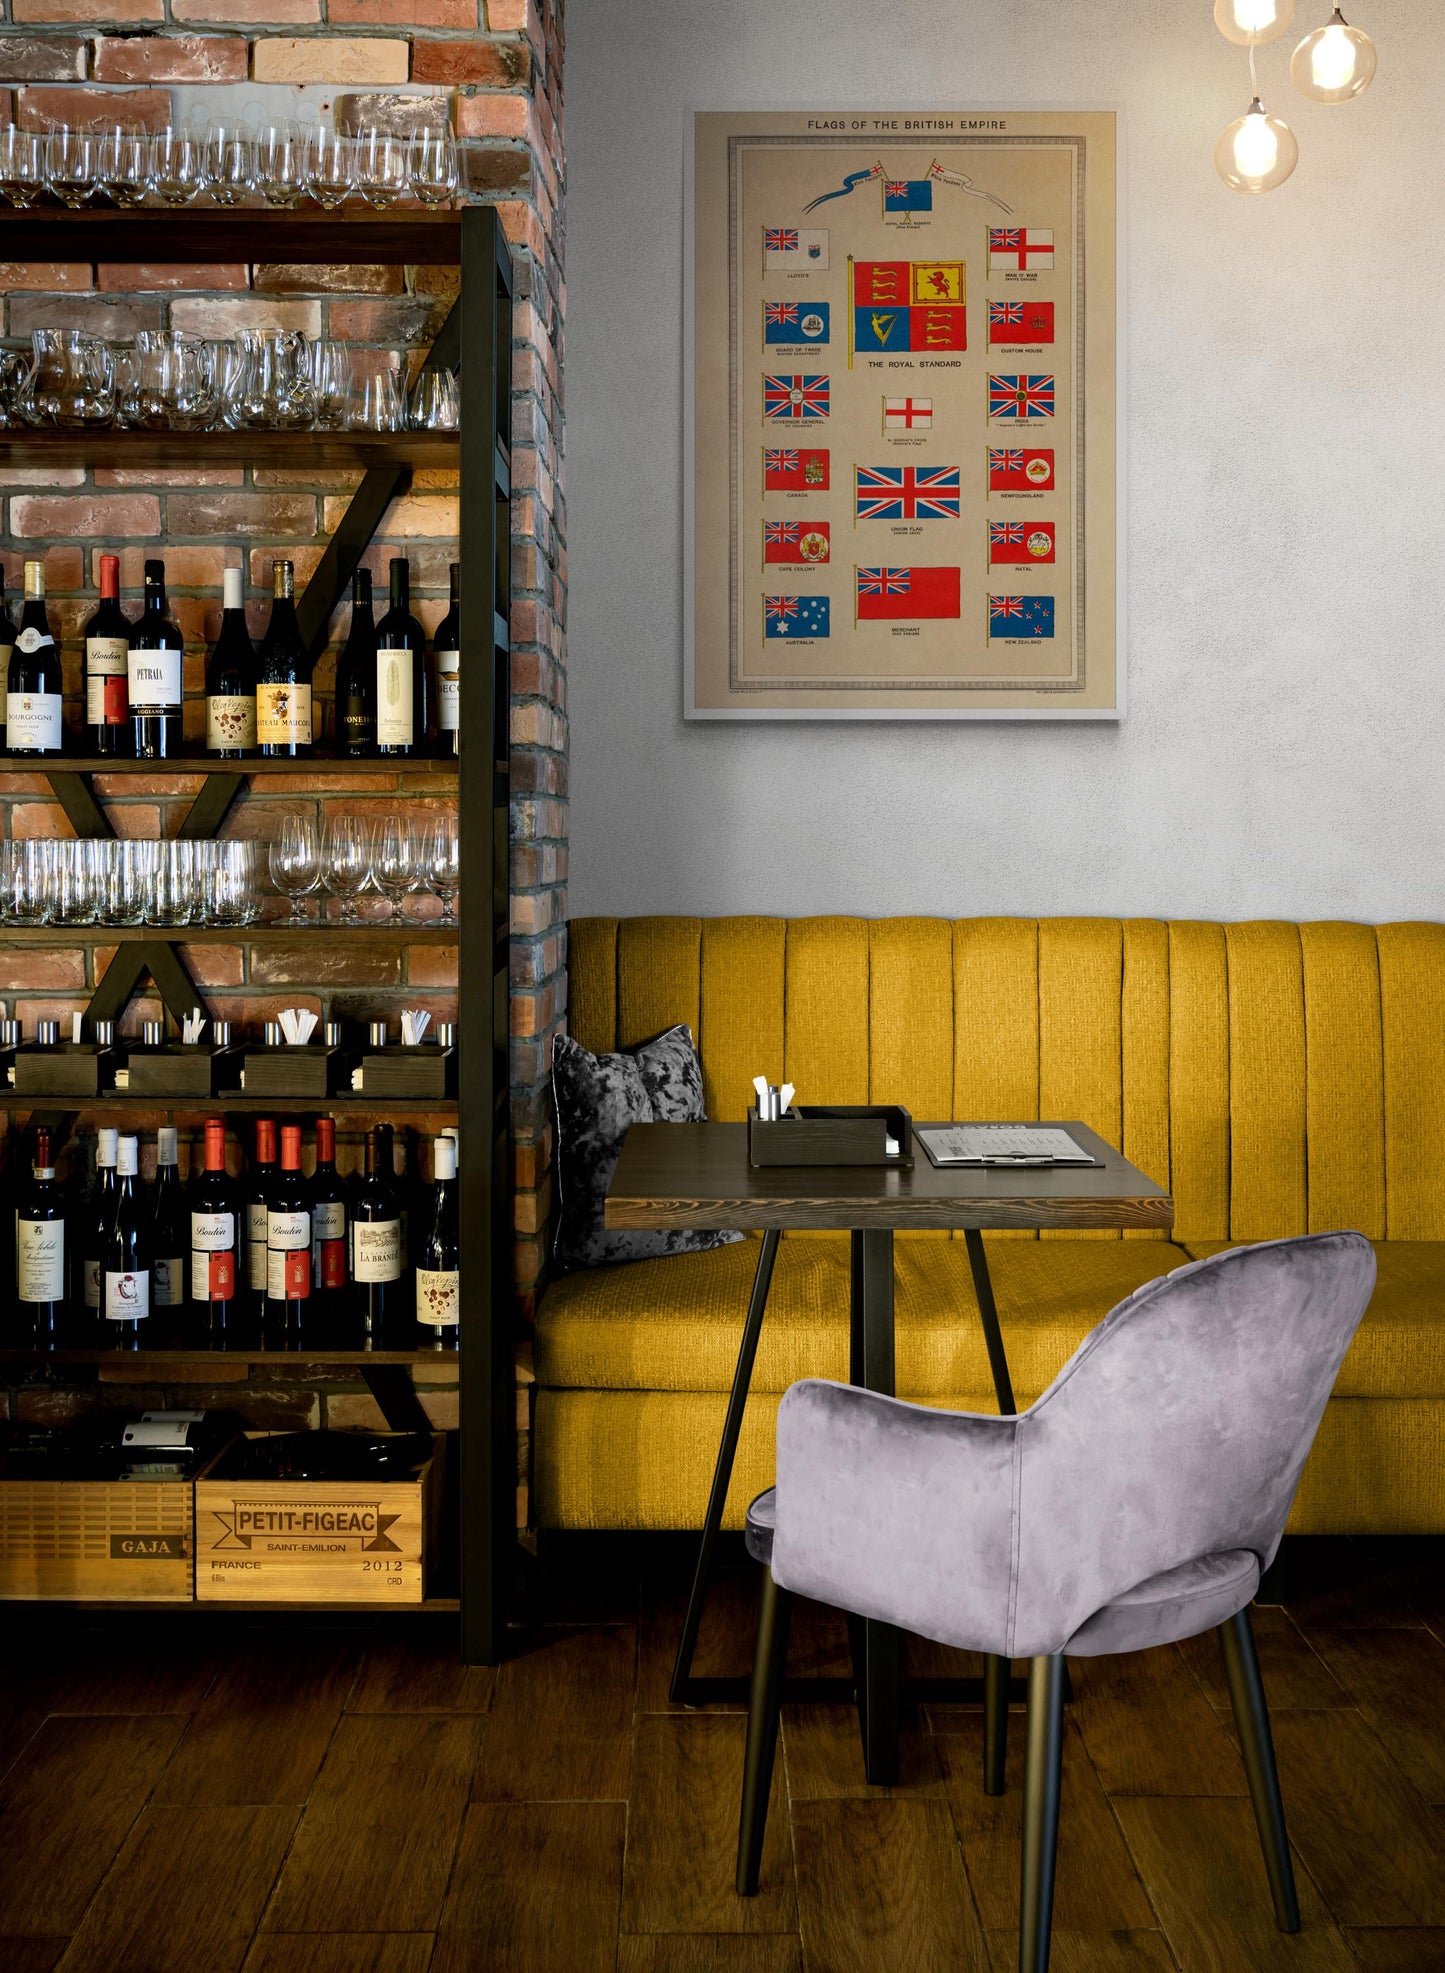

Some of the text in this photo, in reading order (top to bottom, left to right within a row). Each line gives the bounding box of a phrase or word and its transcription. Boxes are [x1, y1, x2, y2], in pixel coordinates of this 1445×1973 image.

[808, 120, 1007, 130] FLAGS OF THE BRITISH EMPIRE
[136, 668, 163, 680] PETRAIA
[360, 1248, 400, 1262] LA BRANDE
[239, 1511, 375, 1532] PETIT-FIGEAC
[121, 1540, 172, 1554] GAJA
[267, 1543, 346, 1552] SAINT-EMILION
[211, 1560, 262, 1569] FRANCE
[362, 1560, 403, 1572] 2012
[387, 1577, 402, 1586] CRD
